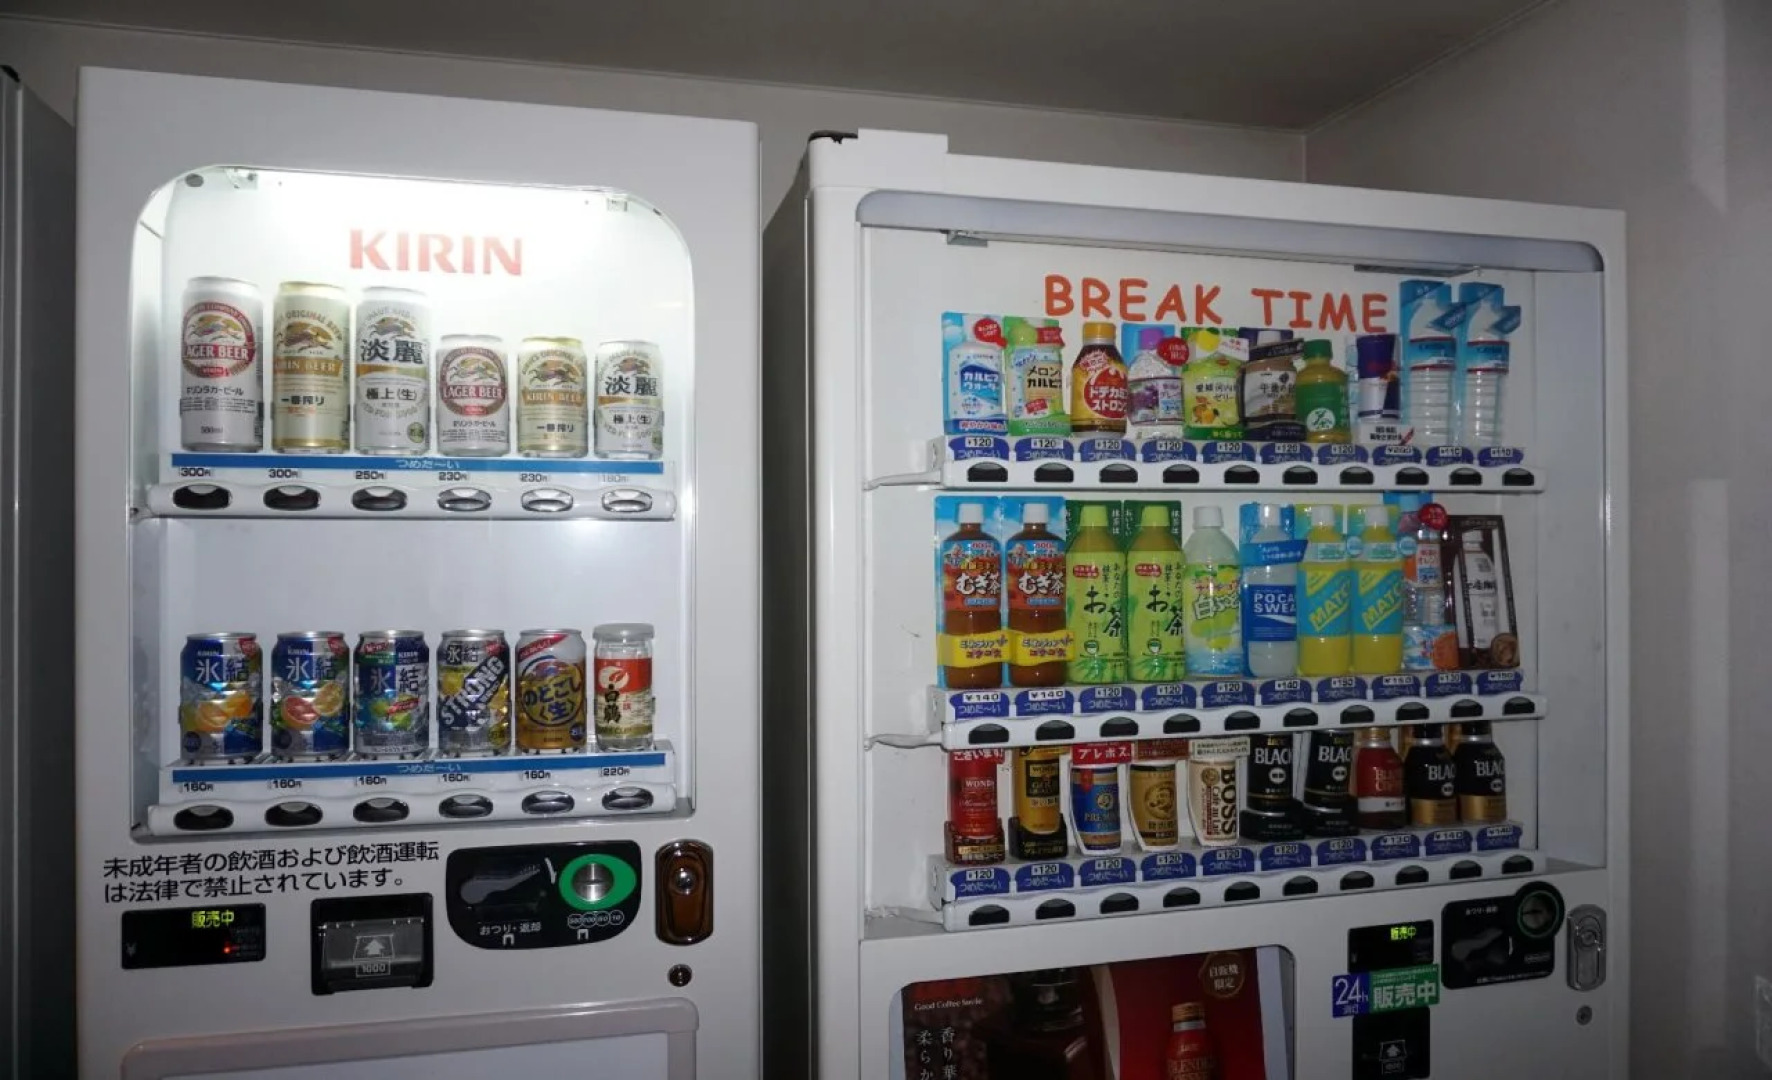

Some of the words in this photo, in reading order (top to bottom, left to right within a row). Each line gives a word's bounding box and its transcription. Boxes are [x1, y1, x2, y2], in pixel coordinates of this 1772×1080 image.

[350, 228, 522, 276] KIRIN
[1044, 274, 1223, 325] BREAK
[1251, 287, 1388, 333] TIME
[219, 348, 249, 358] BEER
[361, 339, 423, 364] 淡麗
[443, 385, 476, 397] LAGER
[605, 375, 658, 396] 淡麗
[1027, 379, 1062, 389] カルピ
[1089, 386, 1127, 397] ドデカミ
[1092, 400, 1127, 412] ストロン
[181, 467, 211, 477] 300円
[269, 469, 298, 479] 300円
[355, 471, 385, 480] 250円
[439, 472, 467, 481] 230円
[519, 473, 547, 483] 230円
[956, 573, 1000, 595] むぎ茶
[1019, 573, 1064, 595] むぎ茶
[1254, 594, 1294, 603] POCA
[1254, 604, 1296, 613] SWEA
[441, 655, 504, 725] STRONG
[1255, 748, 1292, 764] BLAC
[1319, 746, 1350, 763] BLAC
[1428, 765, 1456, 781] BLAC
[1476, 760, 1505, 776] BLAC
[1221, 768, 1236, 835] BOSS
[103, 841, 440, 879] 未成年者の飲酒および飲酒運転
[103, 866, 404, 904] は法律で禁止されています。
[191, 910, 235, 928] 販売中
[1372, 980, 1437, 1009] 販売中
[914, 1002, 934, 1011] Good
